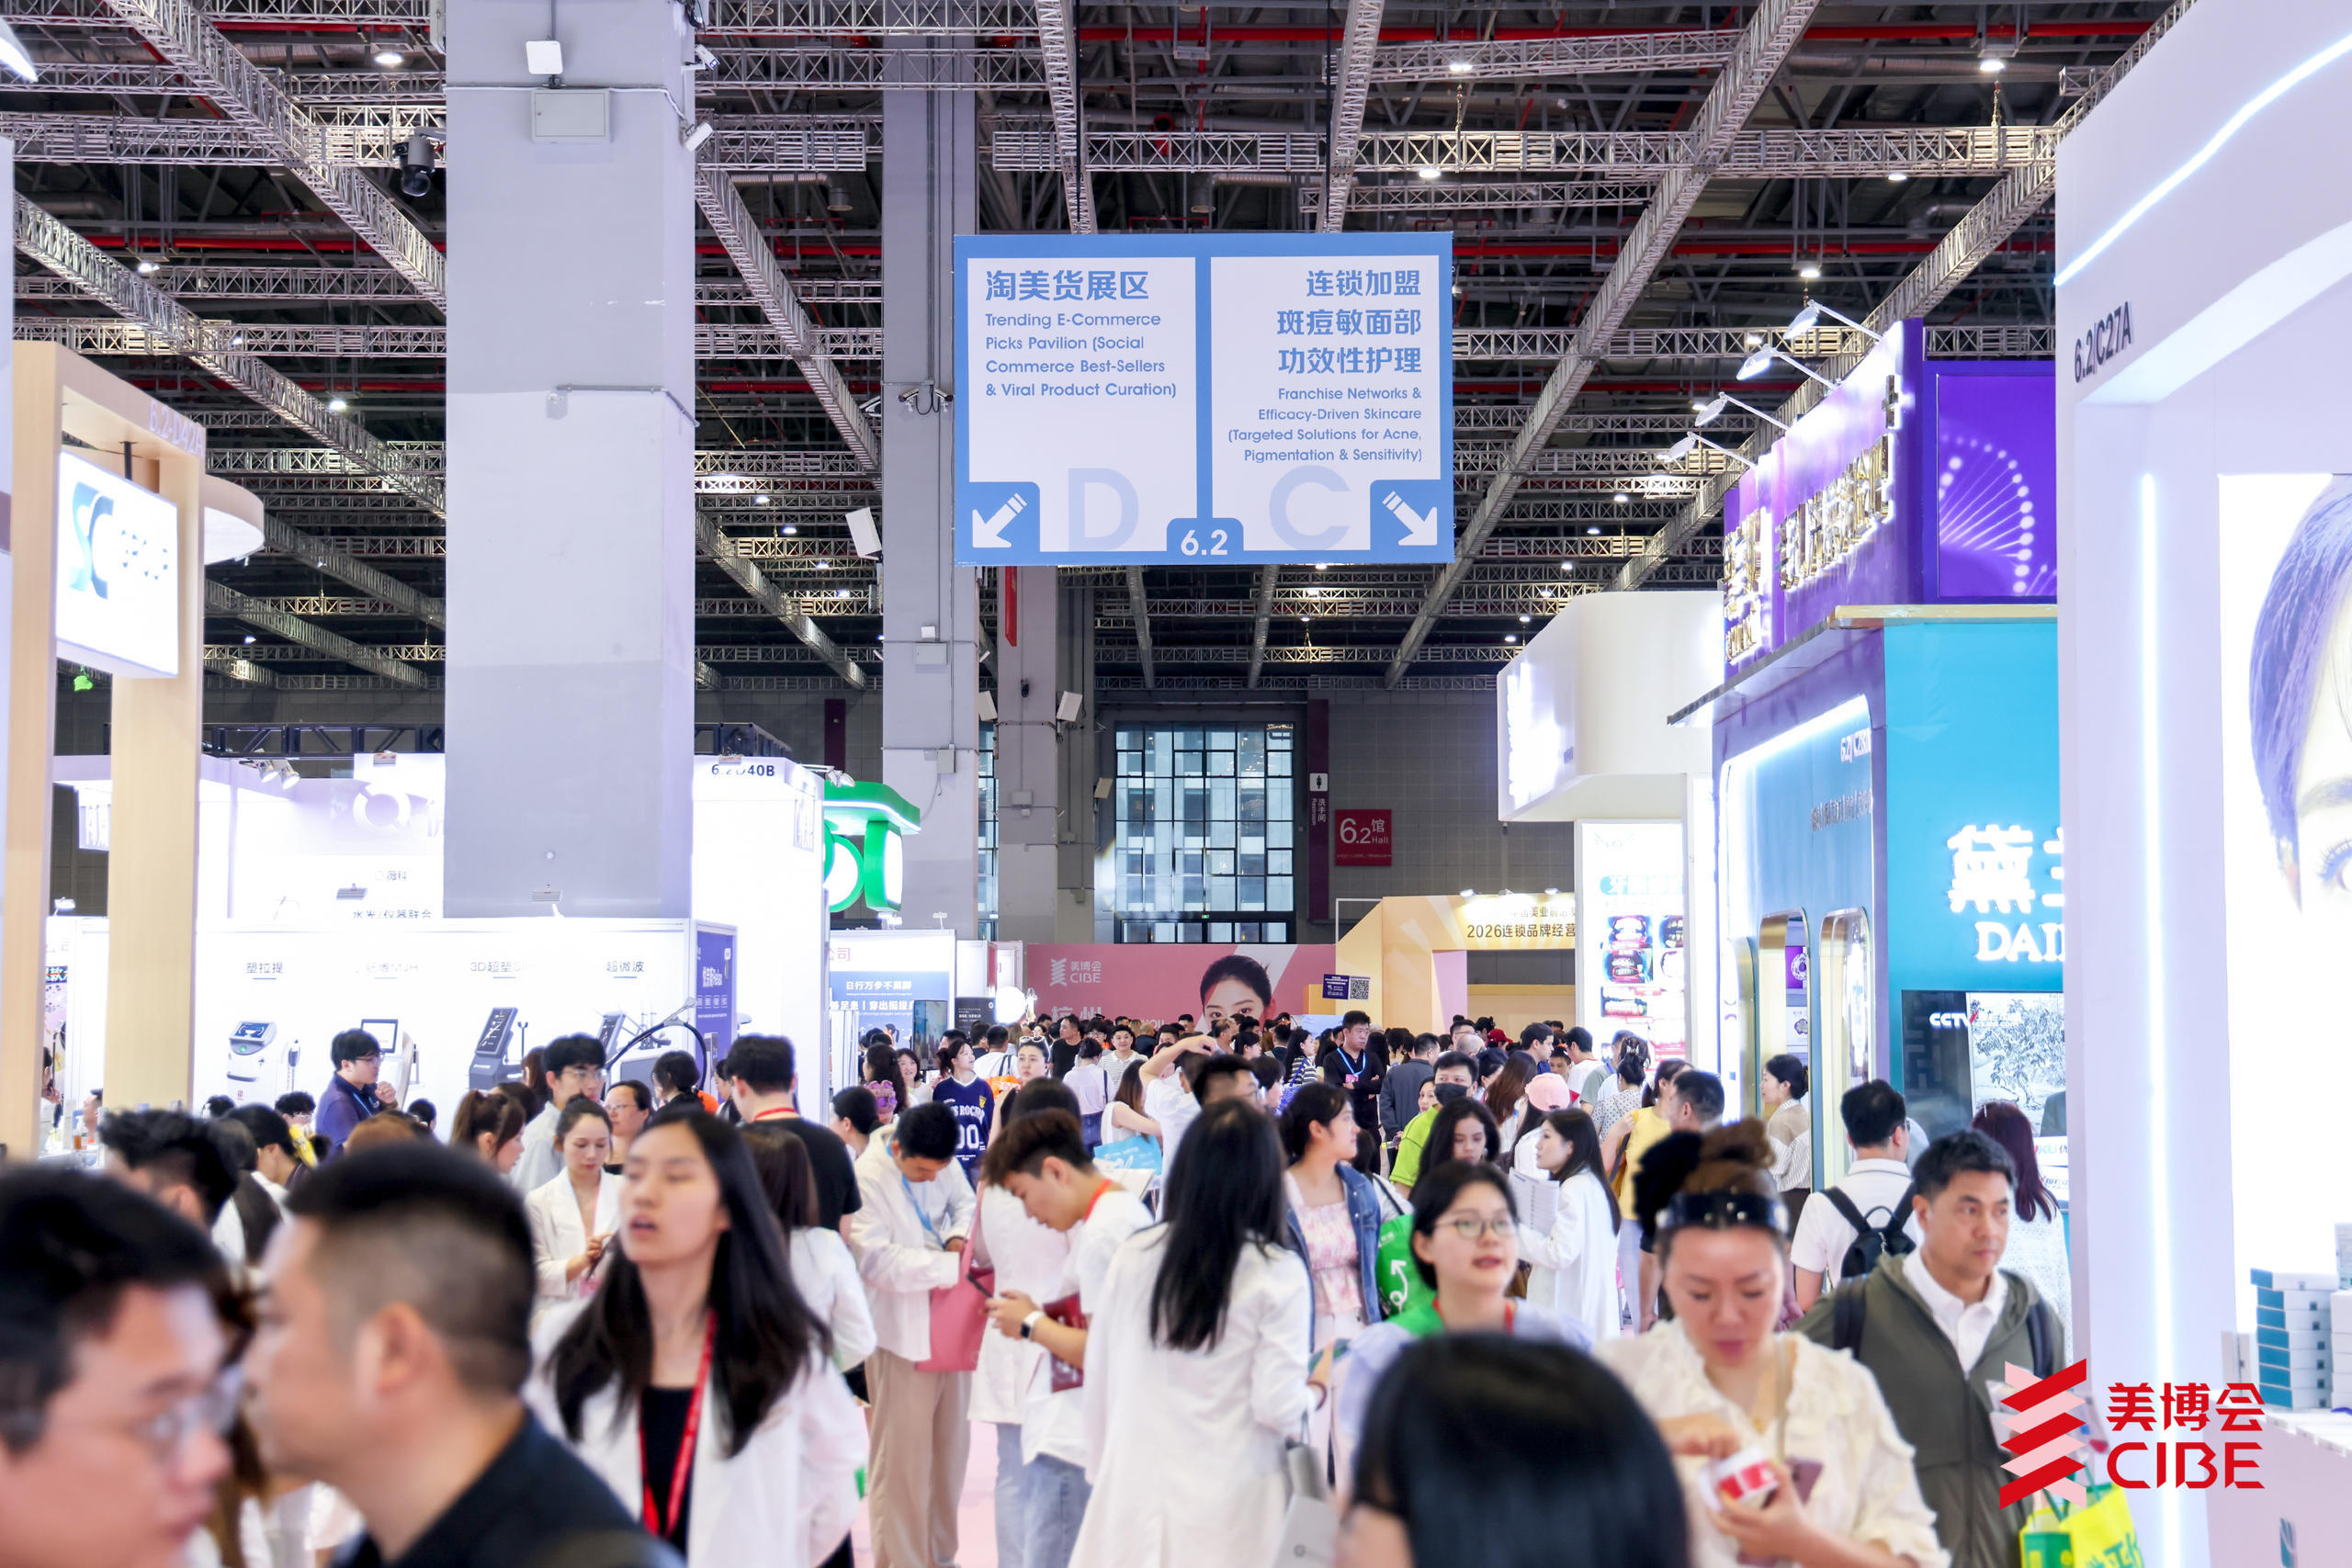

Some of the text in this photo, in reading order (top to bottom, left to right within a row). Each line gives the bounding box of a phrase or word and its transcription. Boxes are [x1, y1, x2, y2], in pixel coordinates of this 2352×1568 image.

[986, 270, 1149, 301] 淘美货展区
[1306, 270, 1421, 297] 连锁加盟
[986, 313, 1161, 329] Trending E-Commerce
[1277, 309, 1421, 335] 斑痘敏面部
[986, 336, 1144, 353] Picks Pavilion (Social
[986, 359, 1165, 374] Commerce Best-Sellers
[1278, 347, 1422, 375] 功效性护理
[986, 382, 1177, 399] & Viral Product Curation)
[1278, 387, 1422, 400] Franchise Networks &
[1259, 408, 1422, 423] Efficacy-Driven Skincare
[1228, 428, 1422, 444] (Targeted Solutions for Acne,
[1244, 448, 1422, 464] Pigmentation & Sensitivity)
[1068, 468, 1139, 551] D
[1269, 465, 1351, 551] C
[1181, 530, 1228, 556] 6.2
[1340, 818, 1385, 844] 6.2 馆
[1372, 836, 1388, 844] Hall
[1947, 824, 2064, 913] 黛
[1069, 961, 1102, 972] 美博会
[1069, 973, 1102, 984] CIBE
[1929, 1010, 1978, 1027] CCTV
